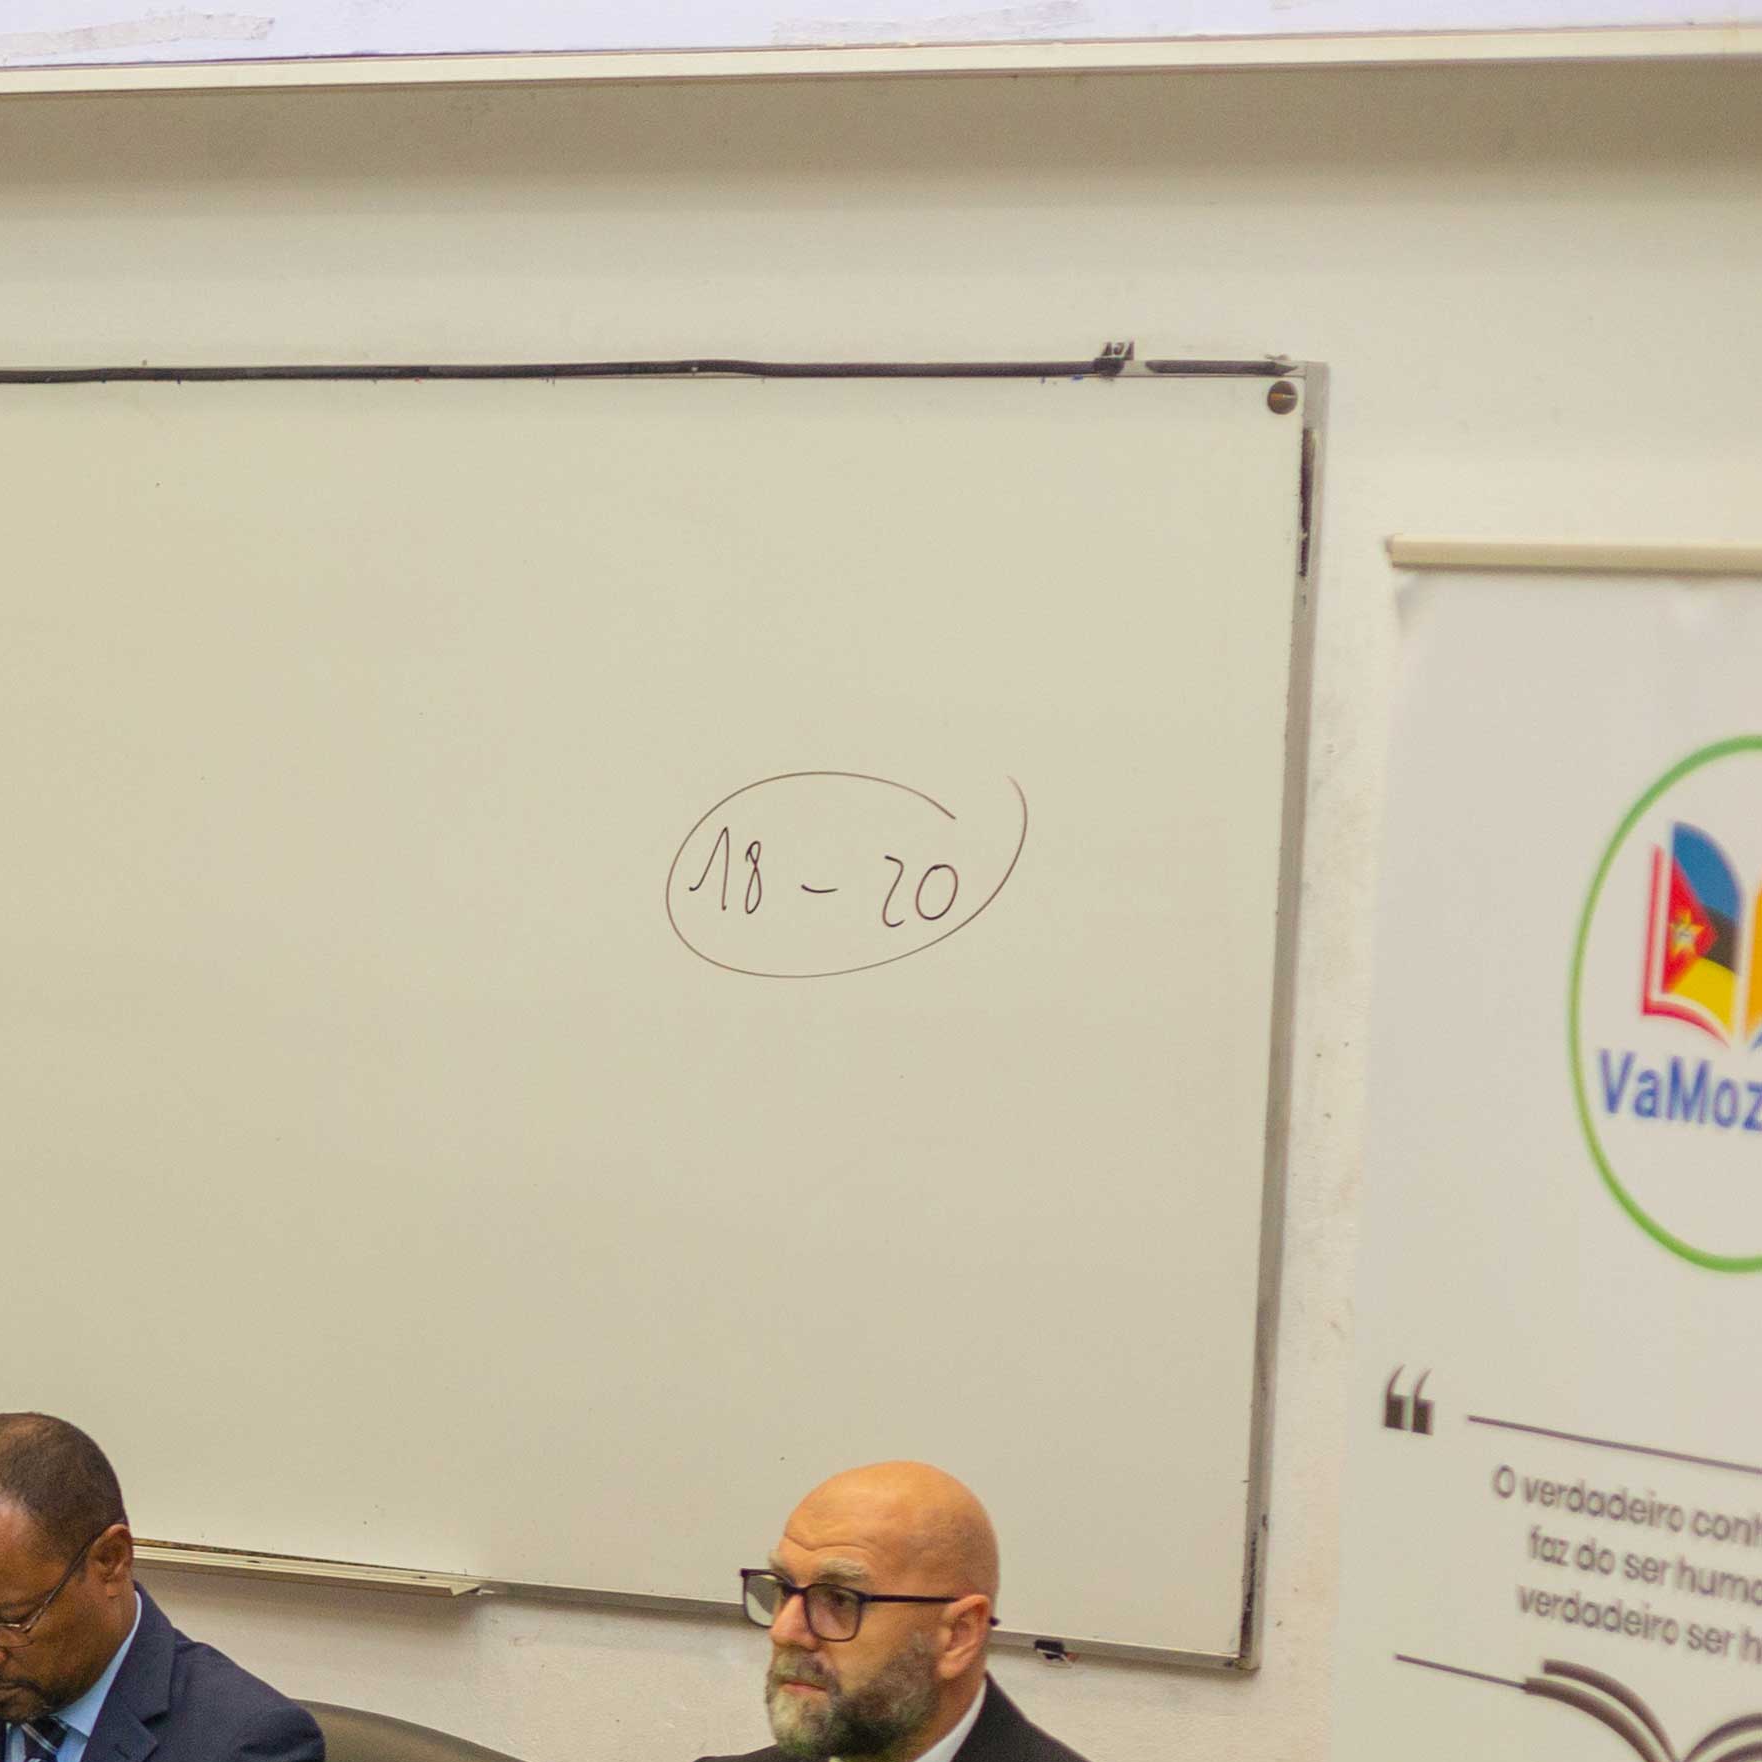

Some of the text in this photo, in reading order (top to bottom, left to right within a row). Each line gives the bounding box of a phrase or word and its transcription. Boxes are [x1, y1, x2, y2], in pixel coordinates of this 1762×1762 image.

[689, 826, 958, 928] 18 20
[1493, 1464, 1516, 1498] O
[1524, 1474, 1685, 1533] verdadeiro
[1530, 1525, 1570, 1567] faz
[1576, 1536, 1616, 1576] do
[1624, 1552, 1671, 1586] ser
[1516, 1584, 1736, 1657] verdadeiro ser
